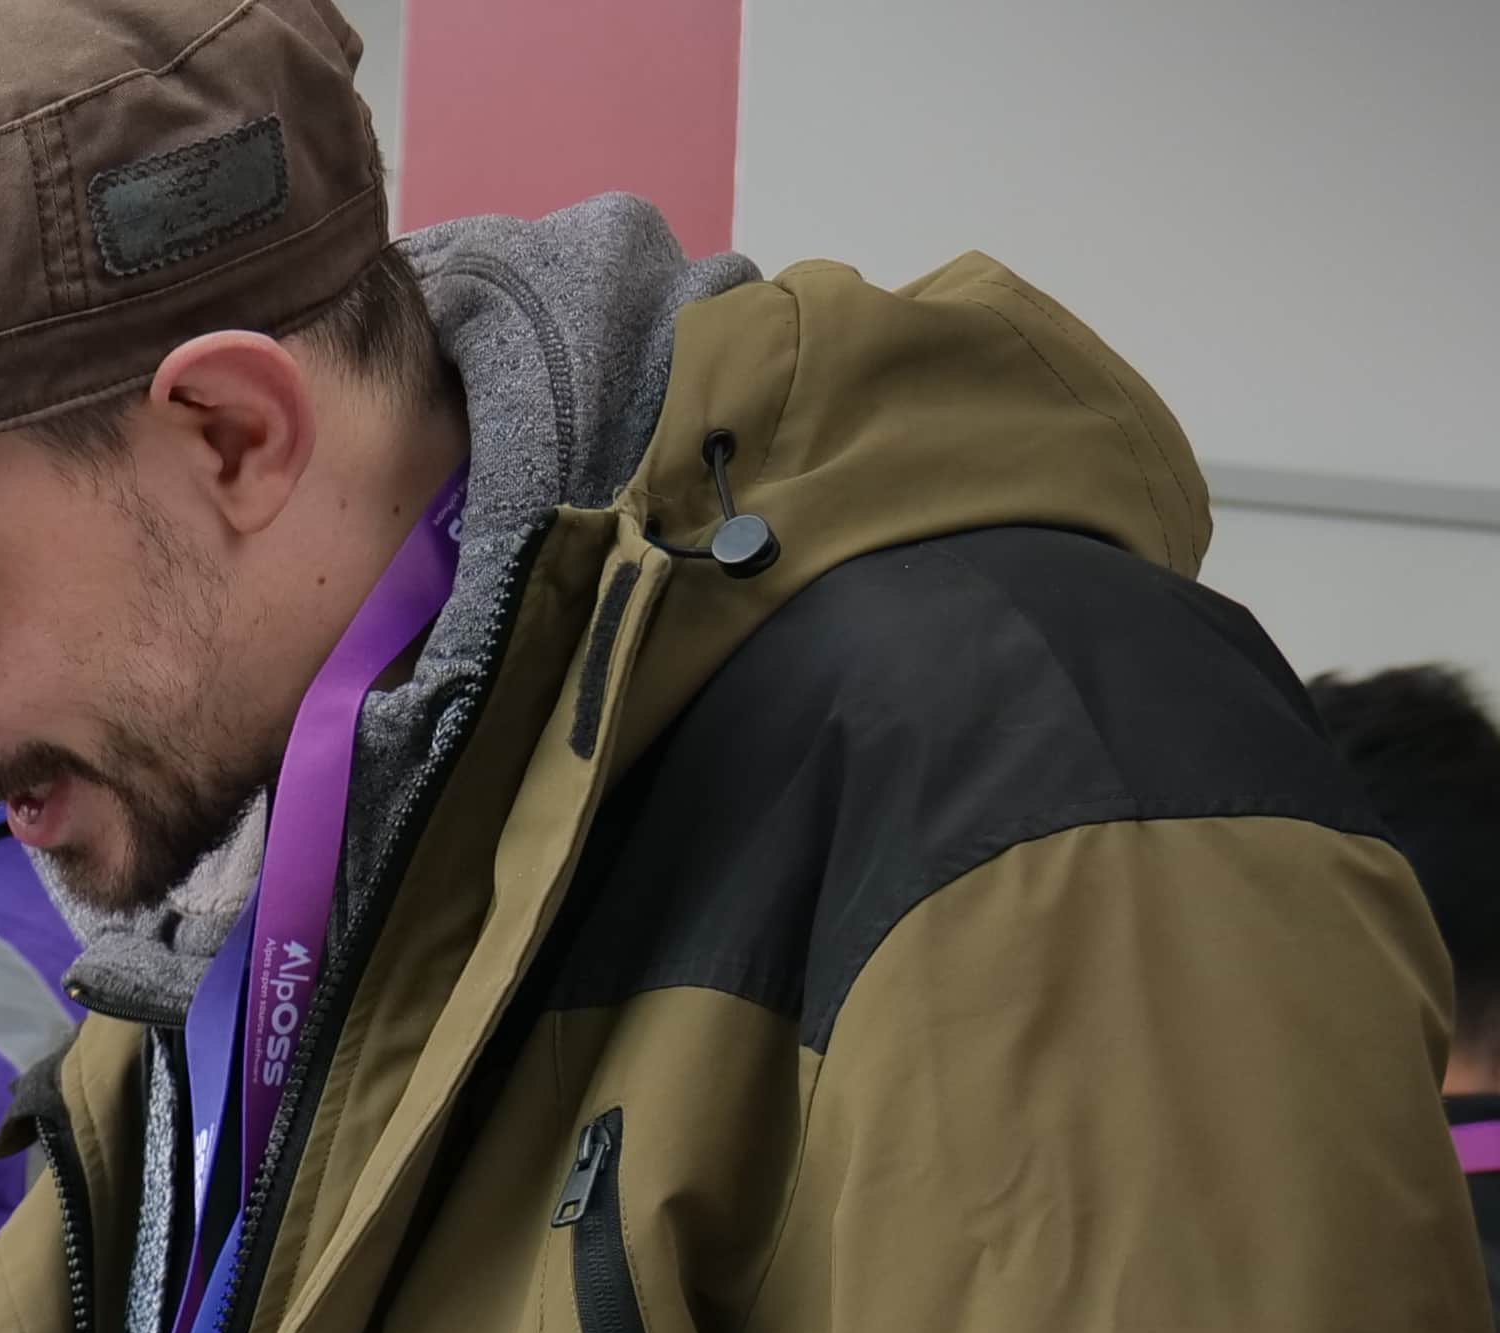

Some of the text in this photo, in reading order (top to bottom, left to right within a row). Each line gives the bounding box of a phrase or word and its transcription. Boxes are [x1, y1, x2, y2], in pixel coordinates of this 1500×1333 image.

[262, 937, 277, 968] Alpes
[260, 969, 271, 999] open
[263, 940, 312, 1087] AlpOSS
